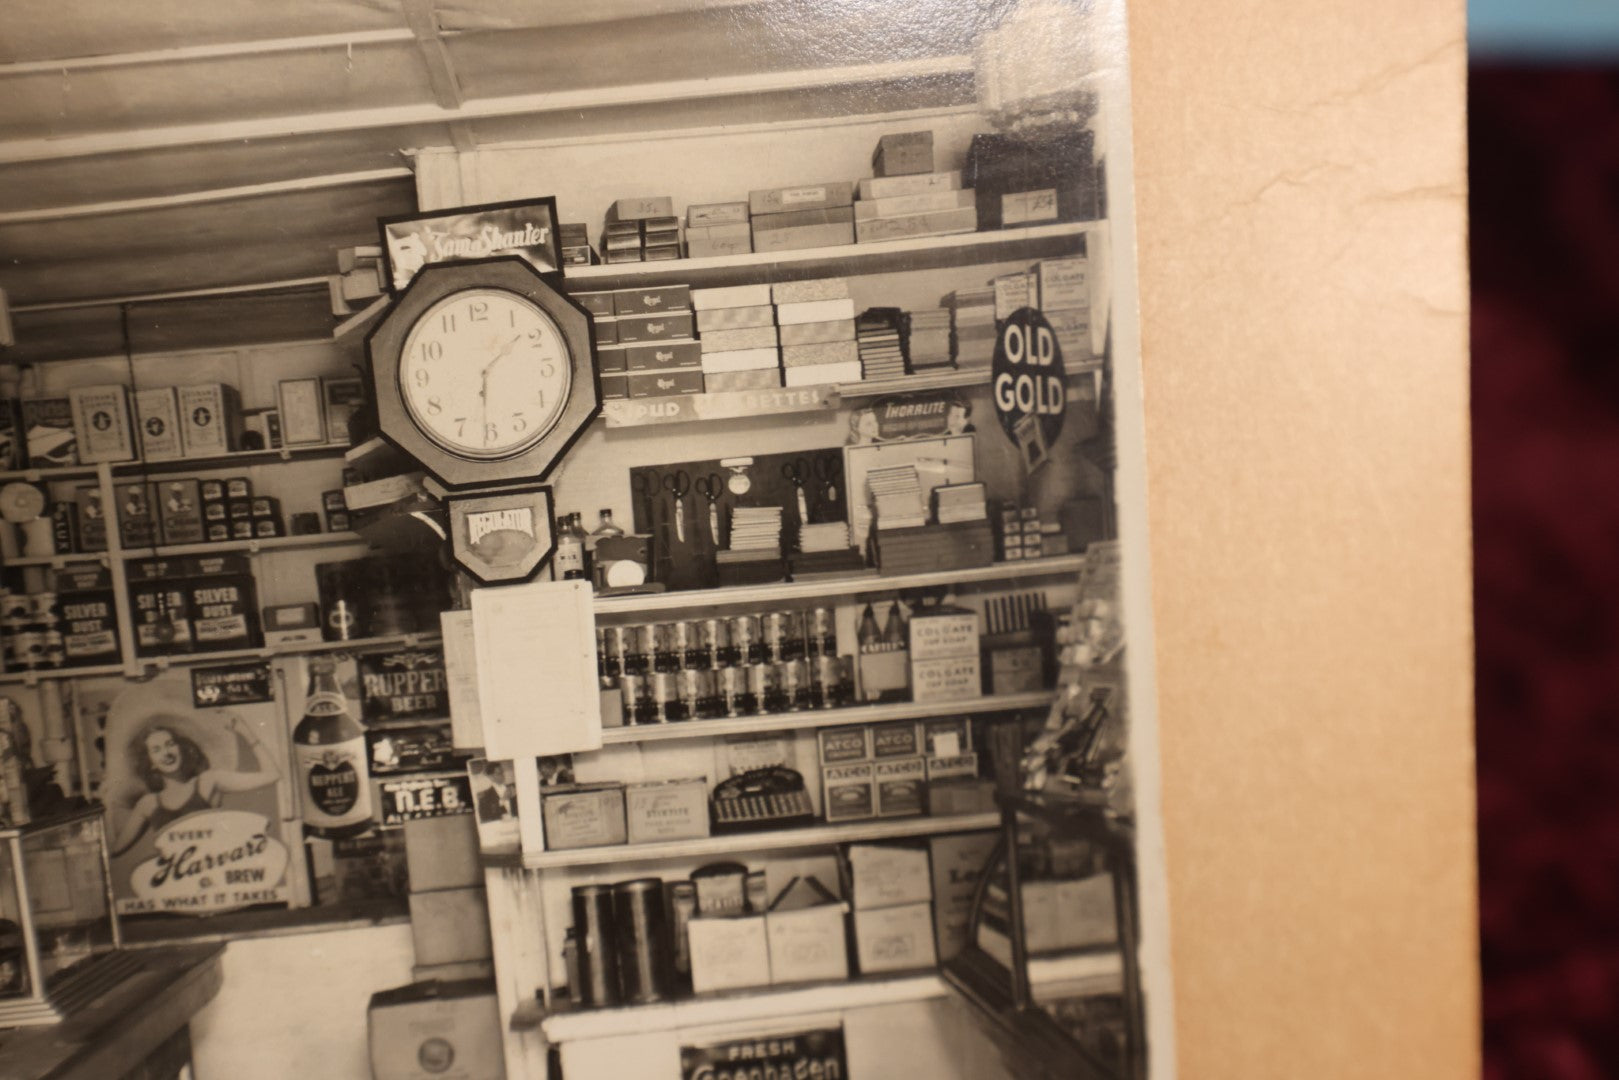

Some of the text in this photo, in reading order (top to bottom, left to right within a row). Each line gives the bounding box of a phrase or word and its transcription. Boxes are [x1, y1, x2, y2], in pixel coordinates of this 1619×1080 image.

[469, 302, 488, 322] 12
[509, 309, 515, 328] 1
[442, 313, 456, 333] 11
[528, 328, 542, 348] 2
[1004, 324, 1054, 366] OLD
[421, 341, 443, 361] 10
[415, 369, 429, 388] 9
[995, 373, 1063, 415] GOLD
[427, 397, 442, 416] 8
[454, 417, 467, 437] 7
[194, 587, 238, 605] SILVER
[202, 604, 233, 618] DUST
[917, 624, 973, 638] COLGATE
[919, 666, 974, 679] COLGATE
[391, 695, 437, 712] BEER
[168, 829, 213, 842] EVERY
[149, 834, 267, 887] Harvard
[225, 868, 265, 885] BREW
[124, 889, 278, 912] HAS WHAT IT TAKES
[728, 1040, 796, 1062] FRESH
